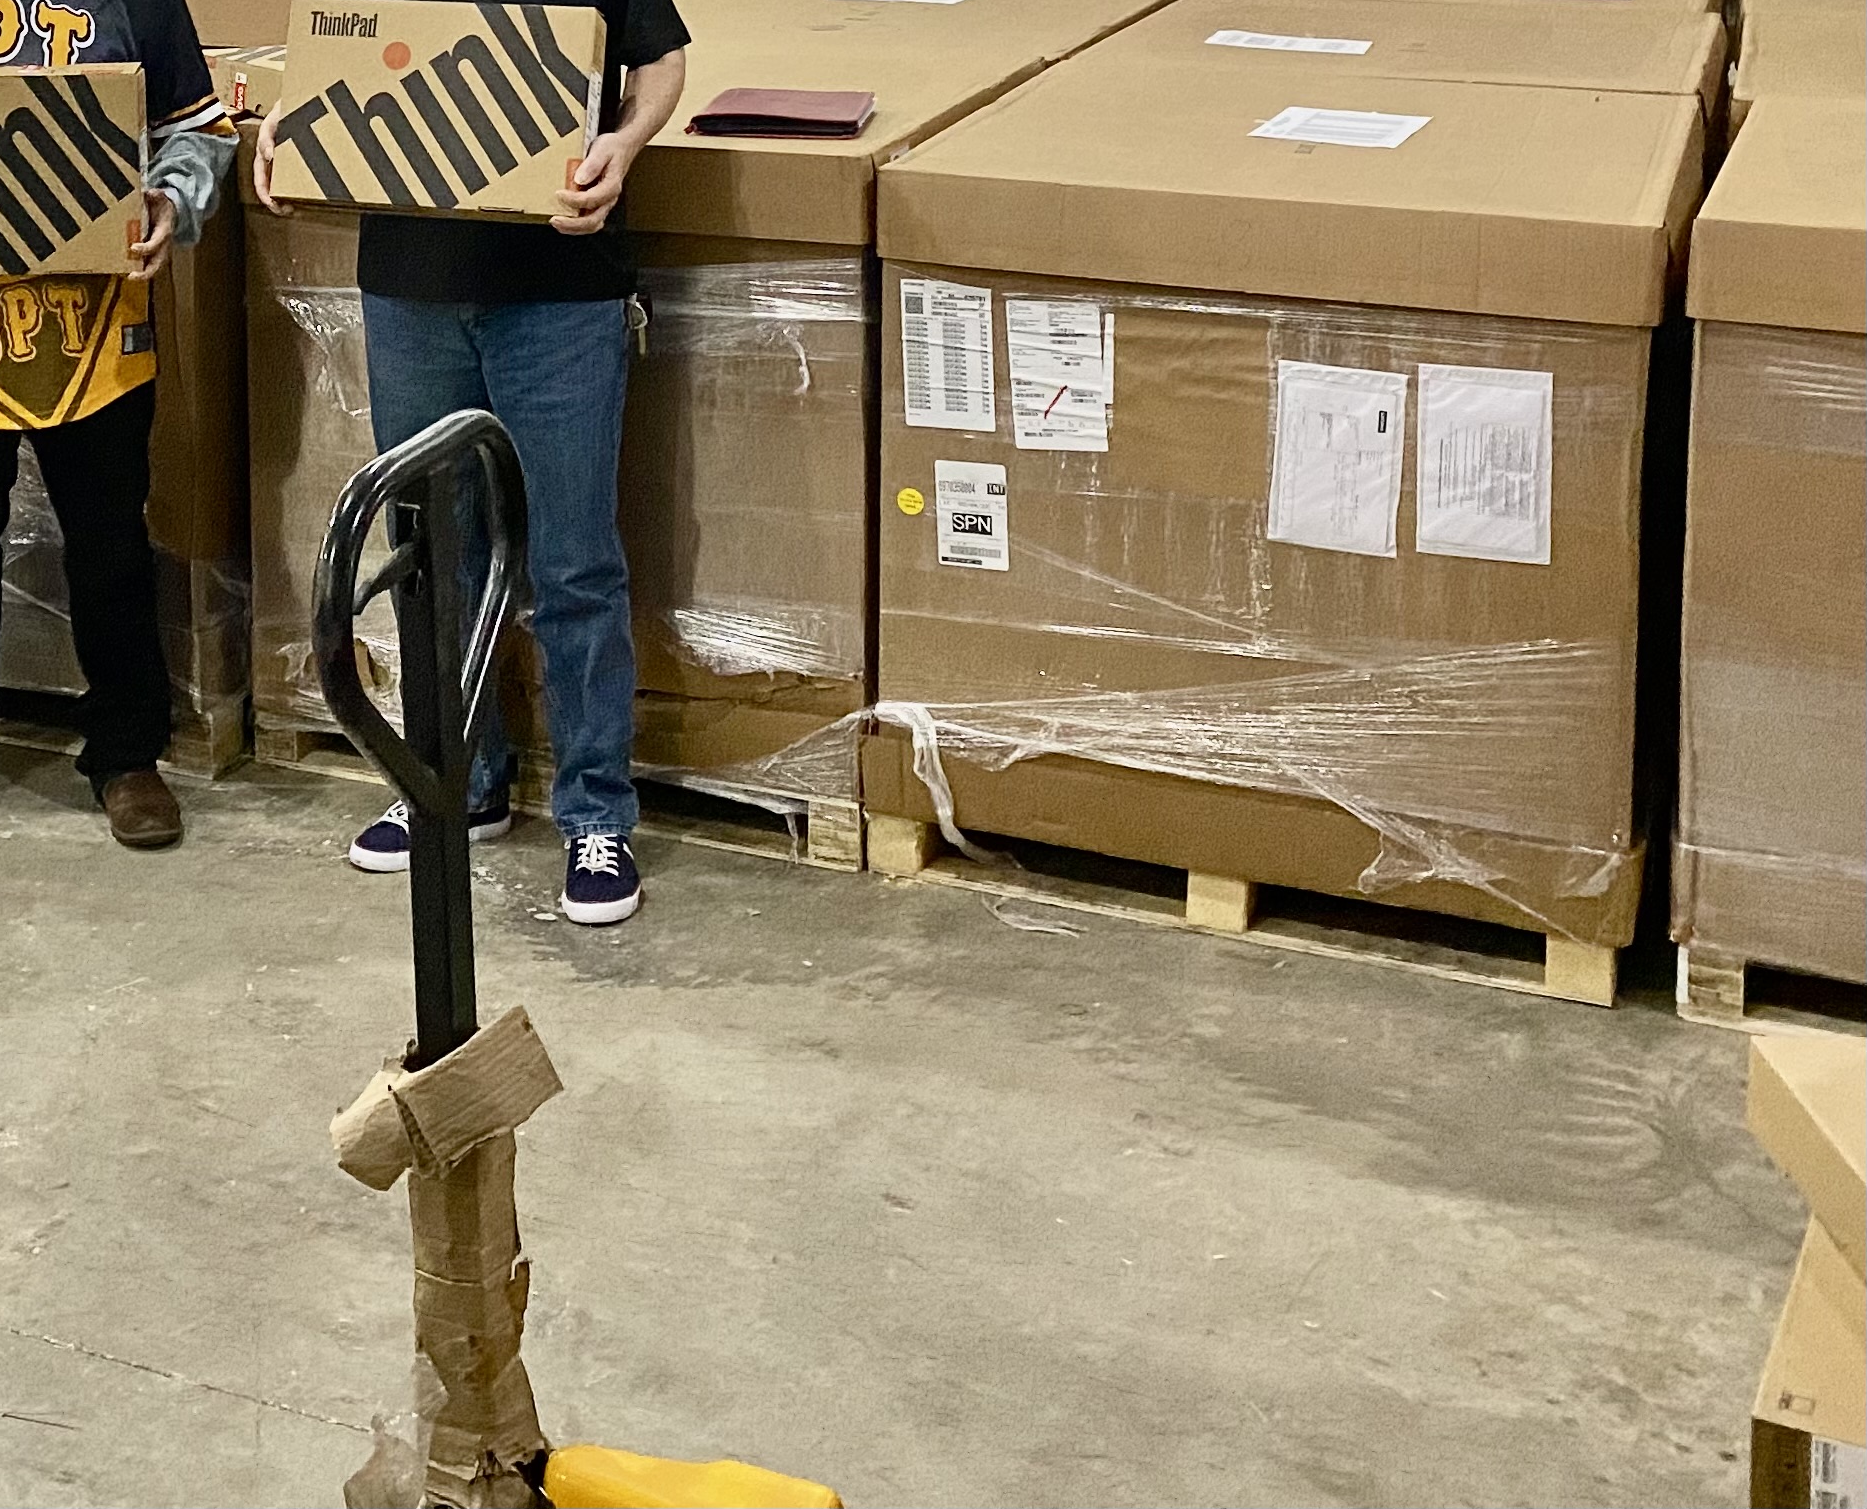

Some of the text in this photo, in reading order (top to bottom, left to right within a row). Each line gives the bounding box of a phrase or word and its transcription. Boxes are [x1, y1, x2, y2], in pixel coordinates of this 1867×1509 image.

[311, 11, 378, 38] ThinkPad
[273, 3, 589, 209] Think
[952, 513, 992, 534] SPN
